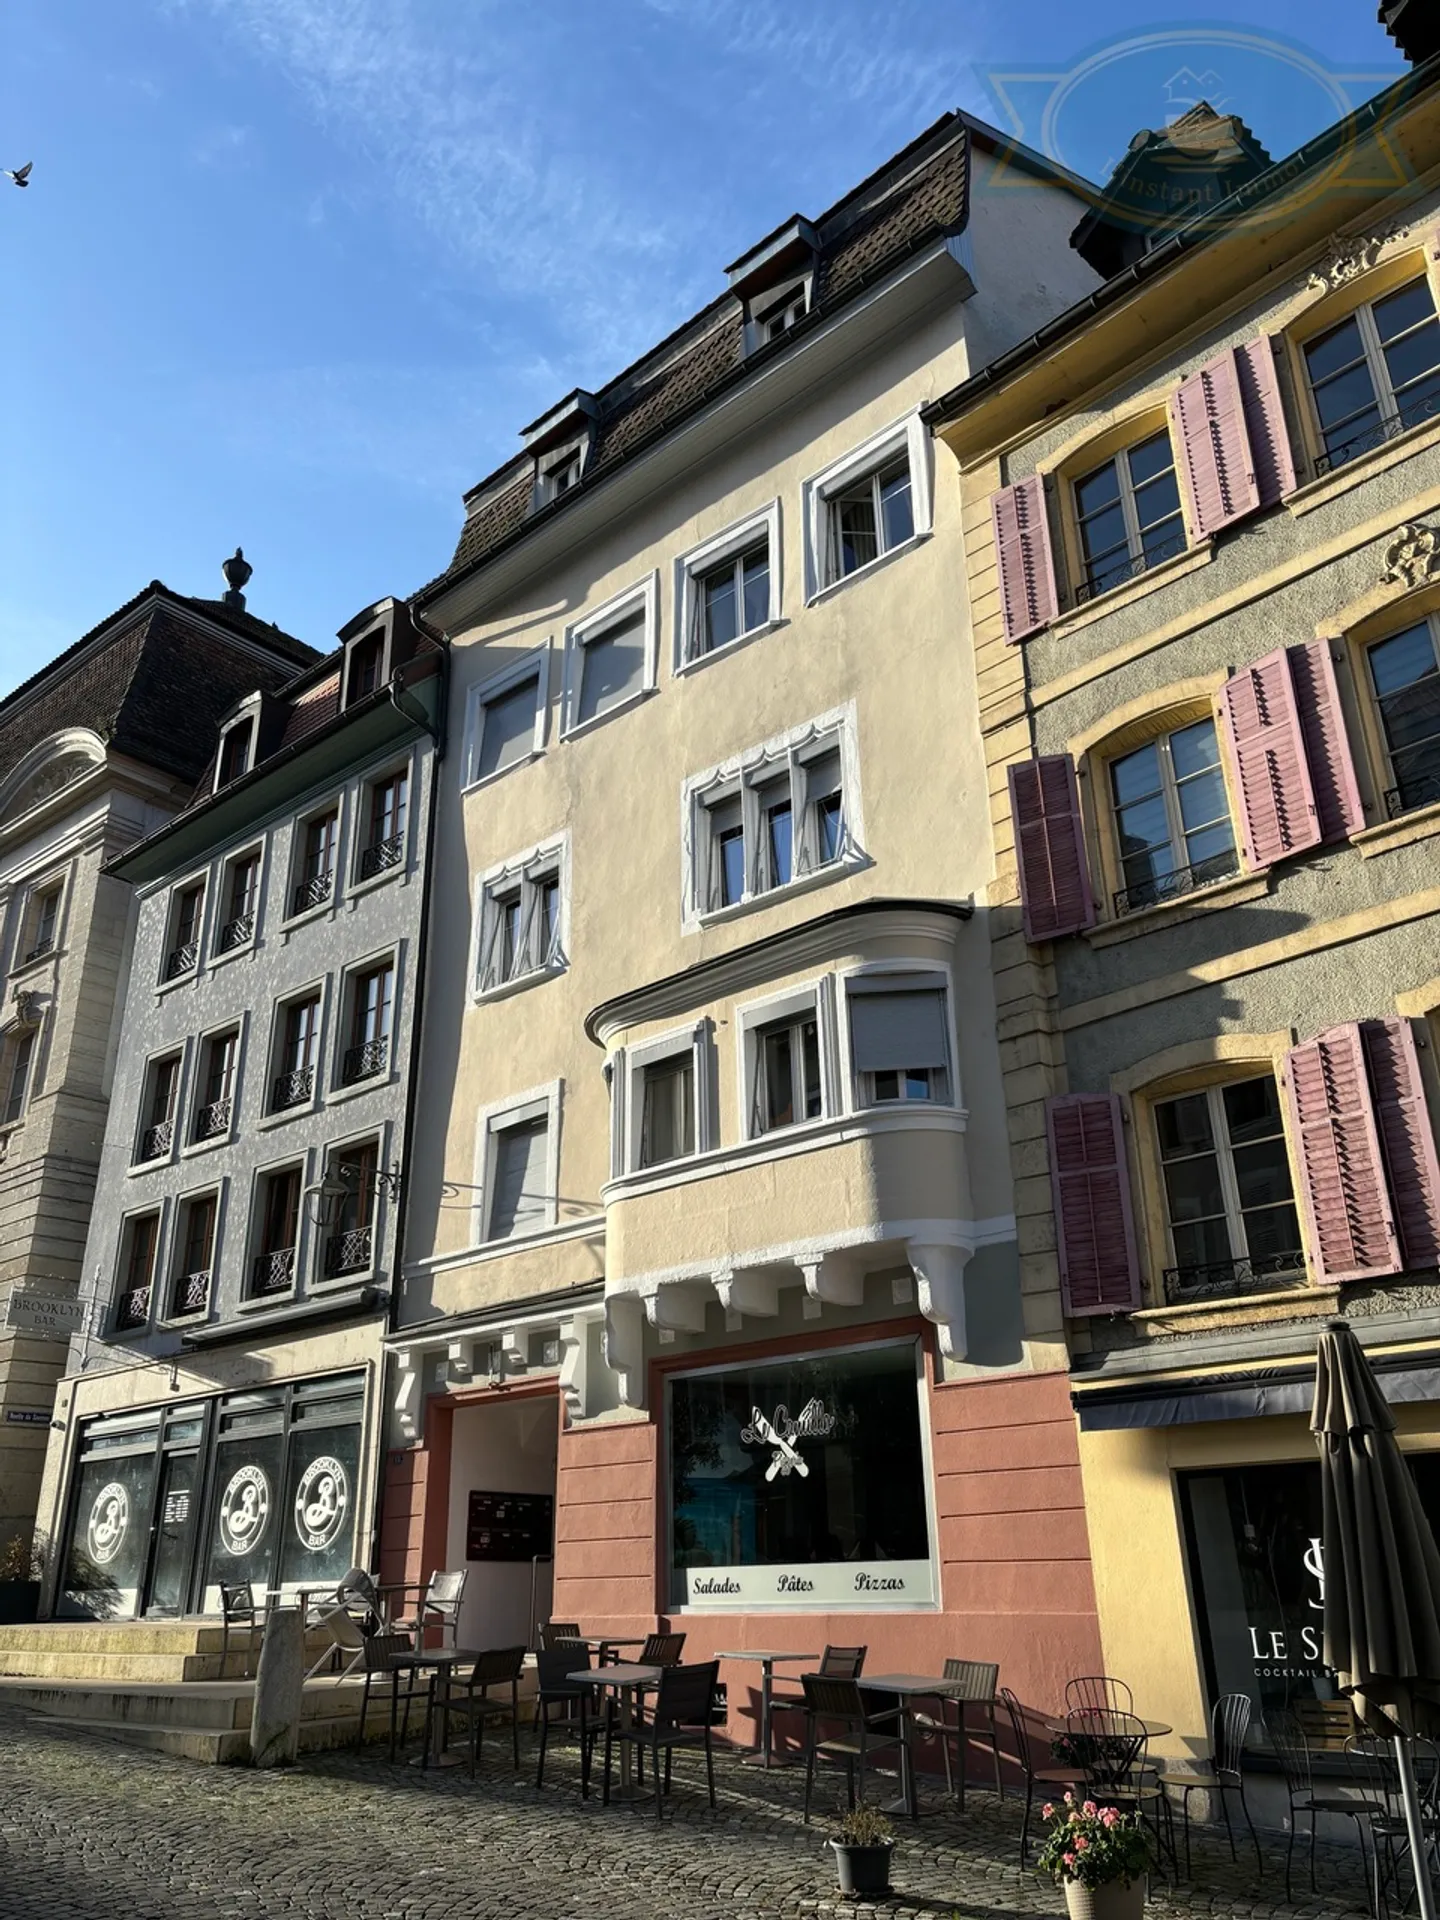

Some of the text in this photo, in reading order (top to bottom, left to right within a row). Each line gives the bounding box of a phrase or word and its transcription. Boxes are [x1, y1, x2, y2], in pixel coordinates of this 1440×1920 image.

[13, 1298, 84, 1318] BROOKLYN
[34, 1315, 56, 1326] BAR
[231, 1540, 248, 1551] BAR
[307, 1534, 326, 1546] BAR
[693, 1571, 906, 1594] Salades Pâtes Pizzas
[1301, 1625, 1325, 1660] S
[1253, 1667, 1317, 1678] COCKTAIL
